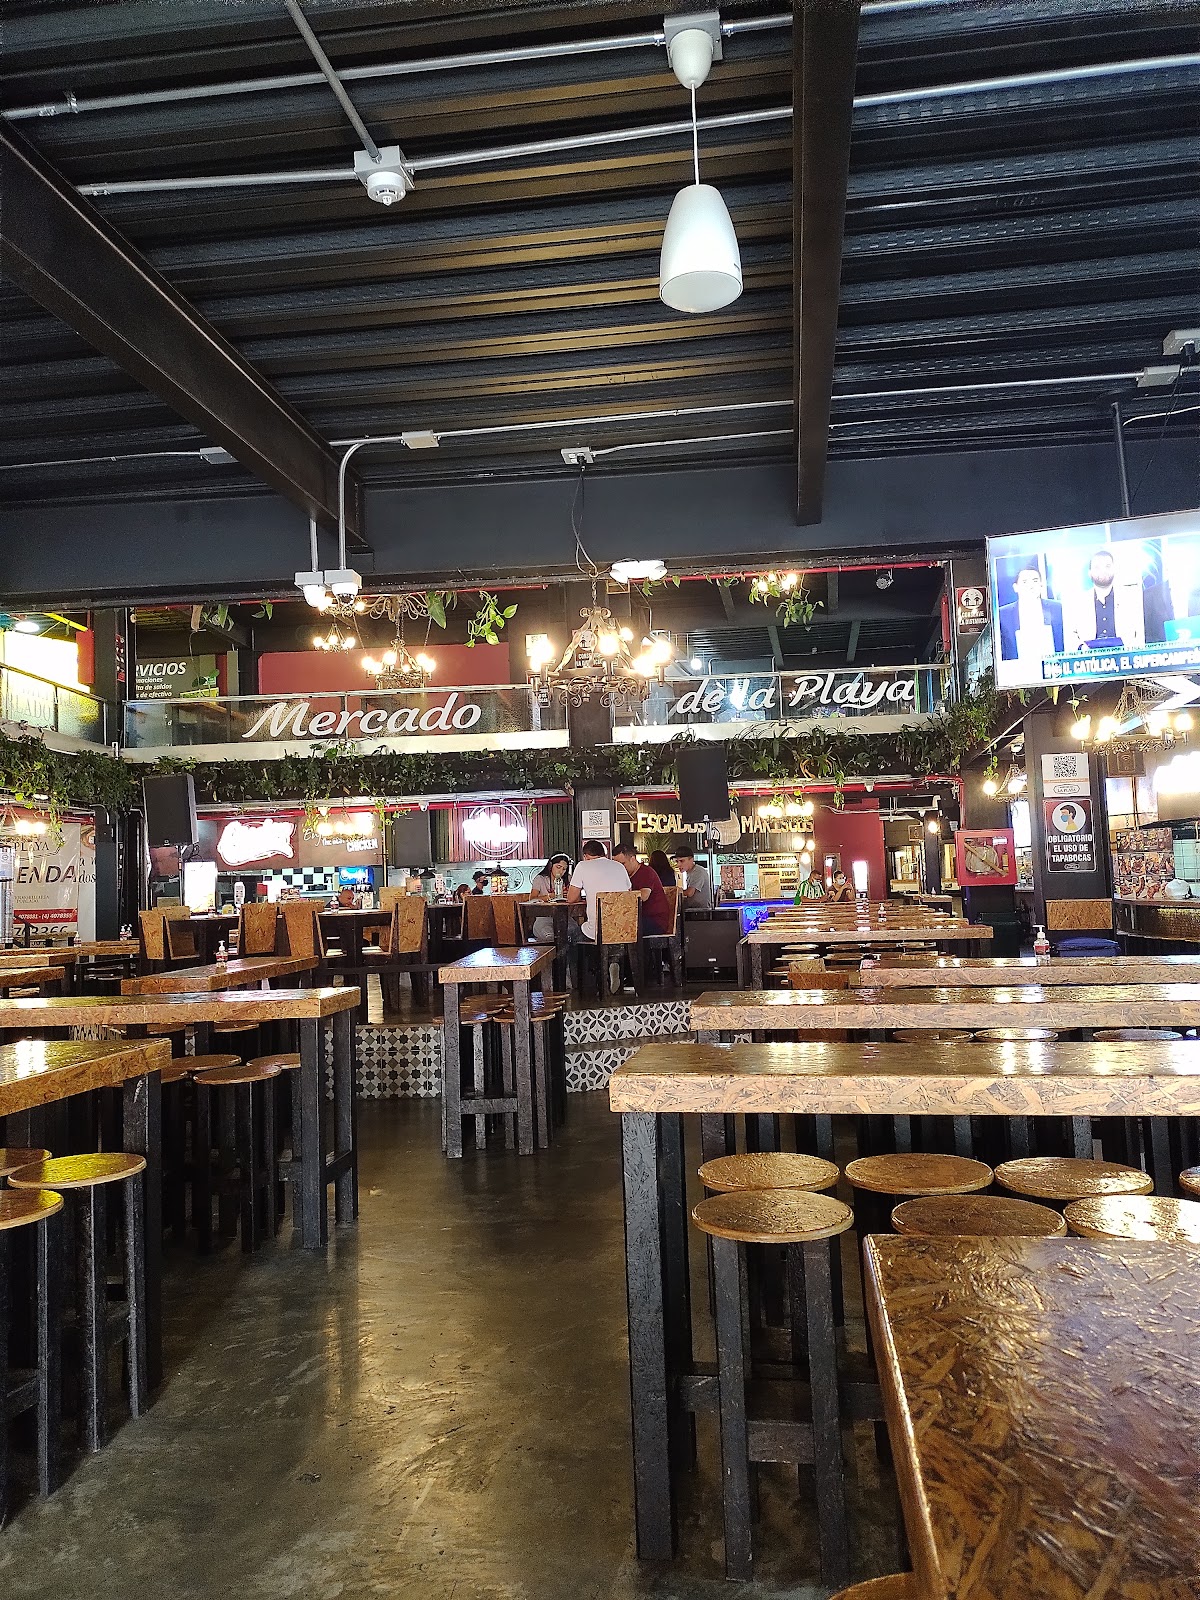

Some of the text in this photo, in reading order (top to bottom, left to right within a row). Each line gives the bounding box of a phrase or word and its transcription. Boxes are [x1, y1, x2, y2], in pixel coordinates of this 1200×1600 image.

[1073, 657, 1119, 674] CATÓLICA,
[1120, 656, 1133, 670] EL
[149, 691, 172, 699] efectivo
[677, 672, 915, 714] de la Playa
[241, 692, 482, 738] Mercado
[1048, 834, 1093, 843] OBLIGATORIO
[1053, 843, 1088, 853] EL USO DE
[1052, 853, 1092, 862] TAPABOCAS
